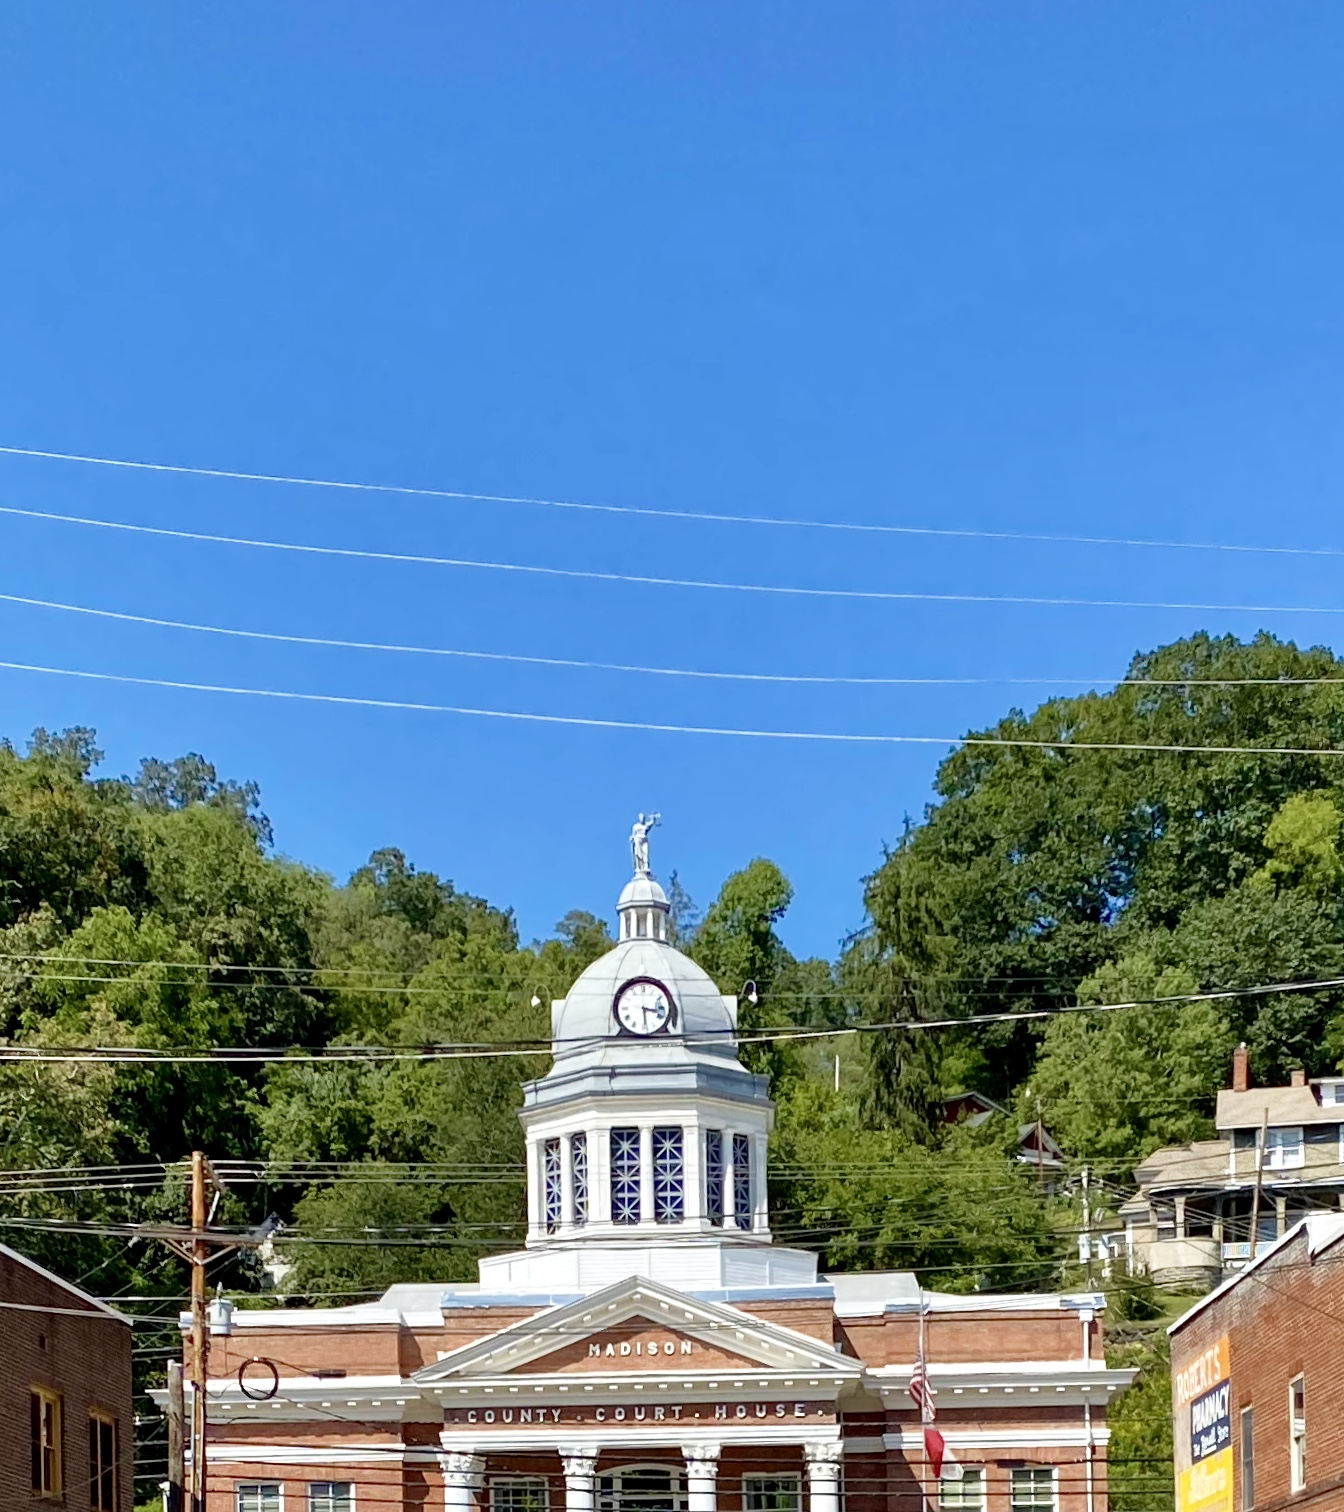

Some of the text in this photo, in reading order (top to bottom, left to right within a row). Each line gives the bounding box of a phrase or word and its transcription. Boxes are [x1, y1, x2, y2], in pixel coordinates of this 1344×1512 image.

[588, 1340, 693, 1357] MADISON
[467, 1403, 806, 1424] COUNTY COURT HOUSE
[1192, 1383, 1230, 1435] PHARMACY
